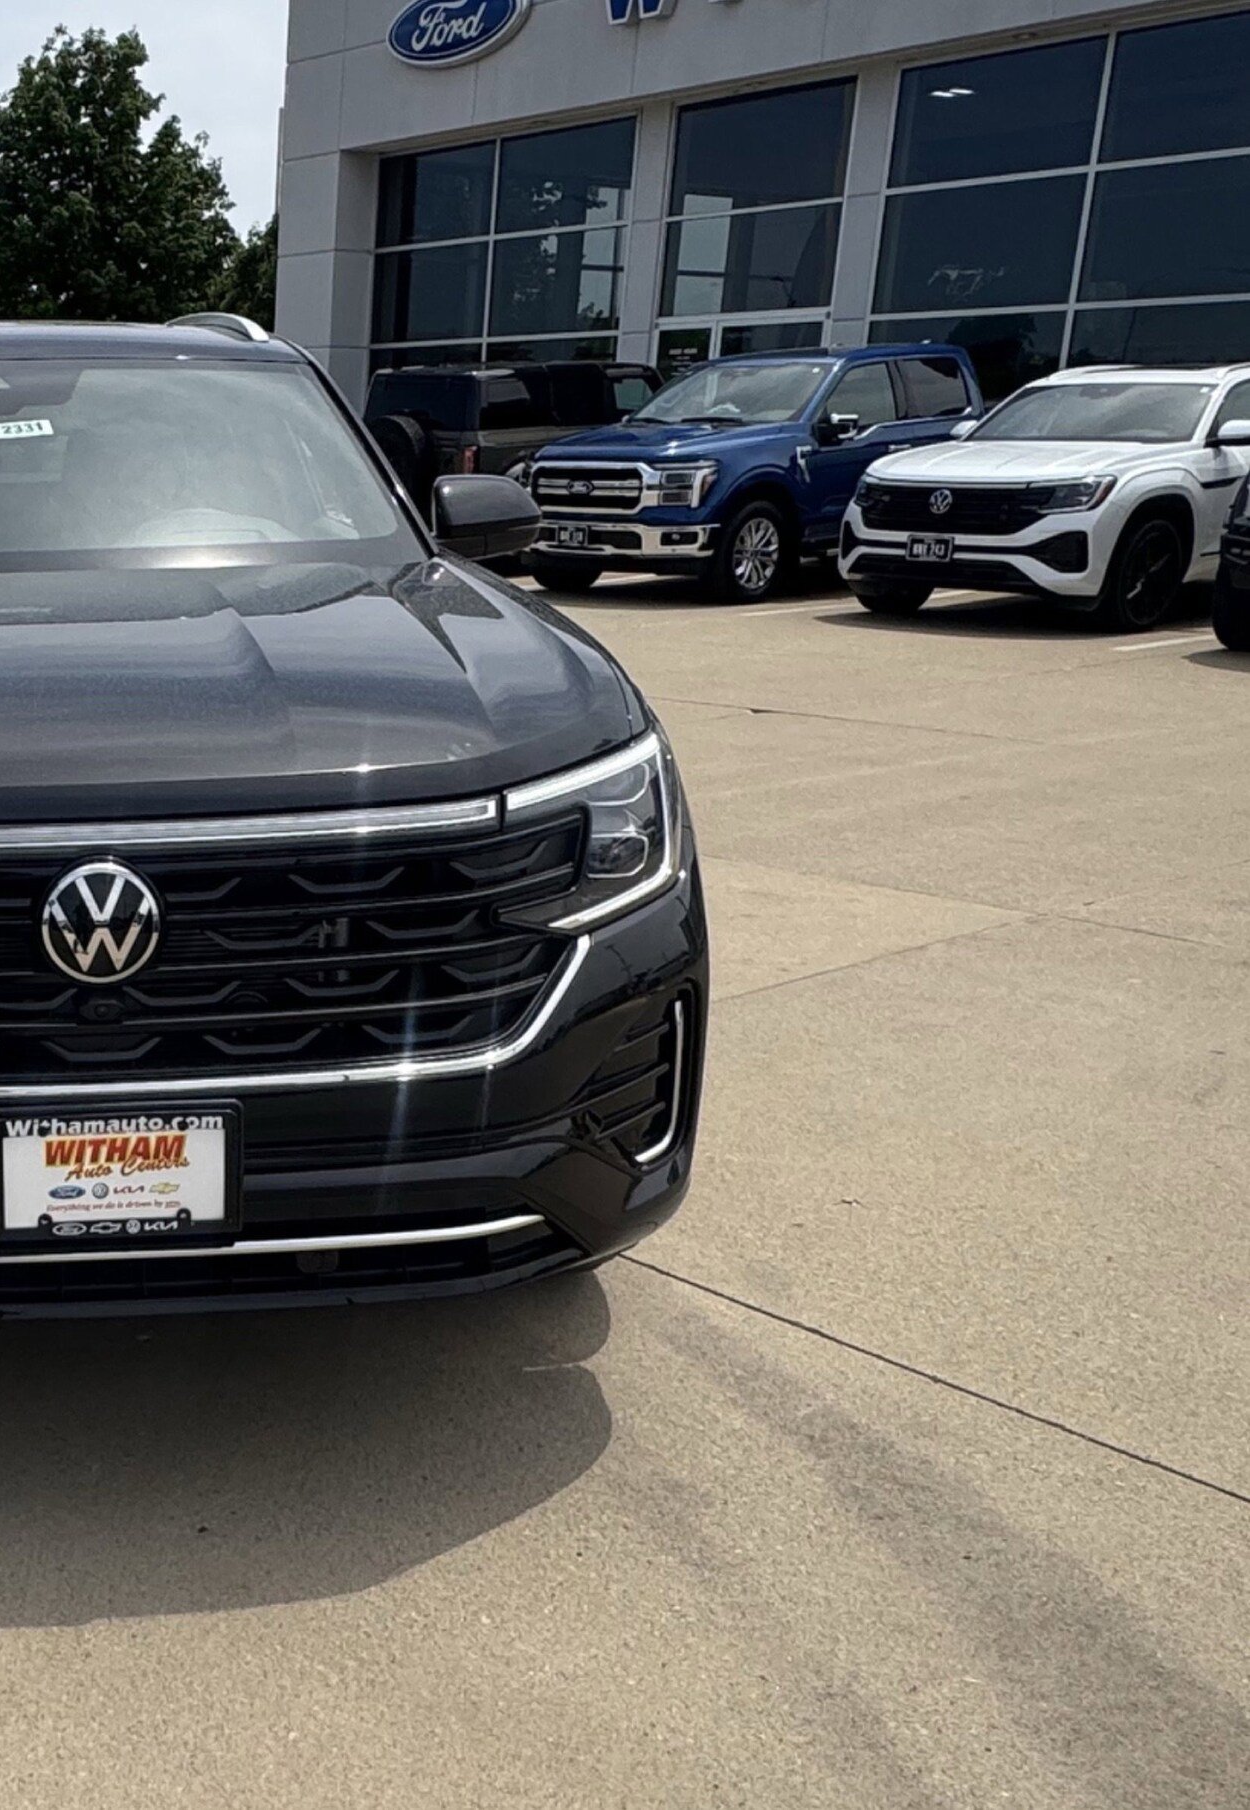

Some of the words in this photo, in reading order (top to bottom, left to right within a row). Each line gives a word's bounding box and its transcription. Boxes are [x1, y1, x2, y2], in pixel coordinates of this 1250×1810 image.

[411, 0, 487, 51] Ford
[44, 1134, 187, 1166] WITHAM
[64, 1161, 113, 1181] Auto
